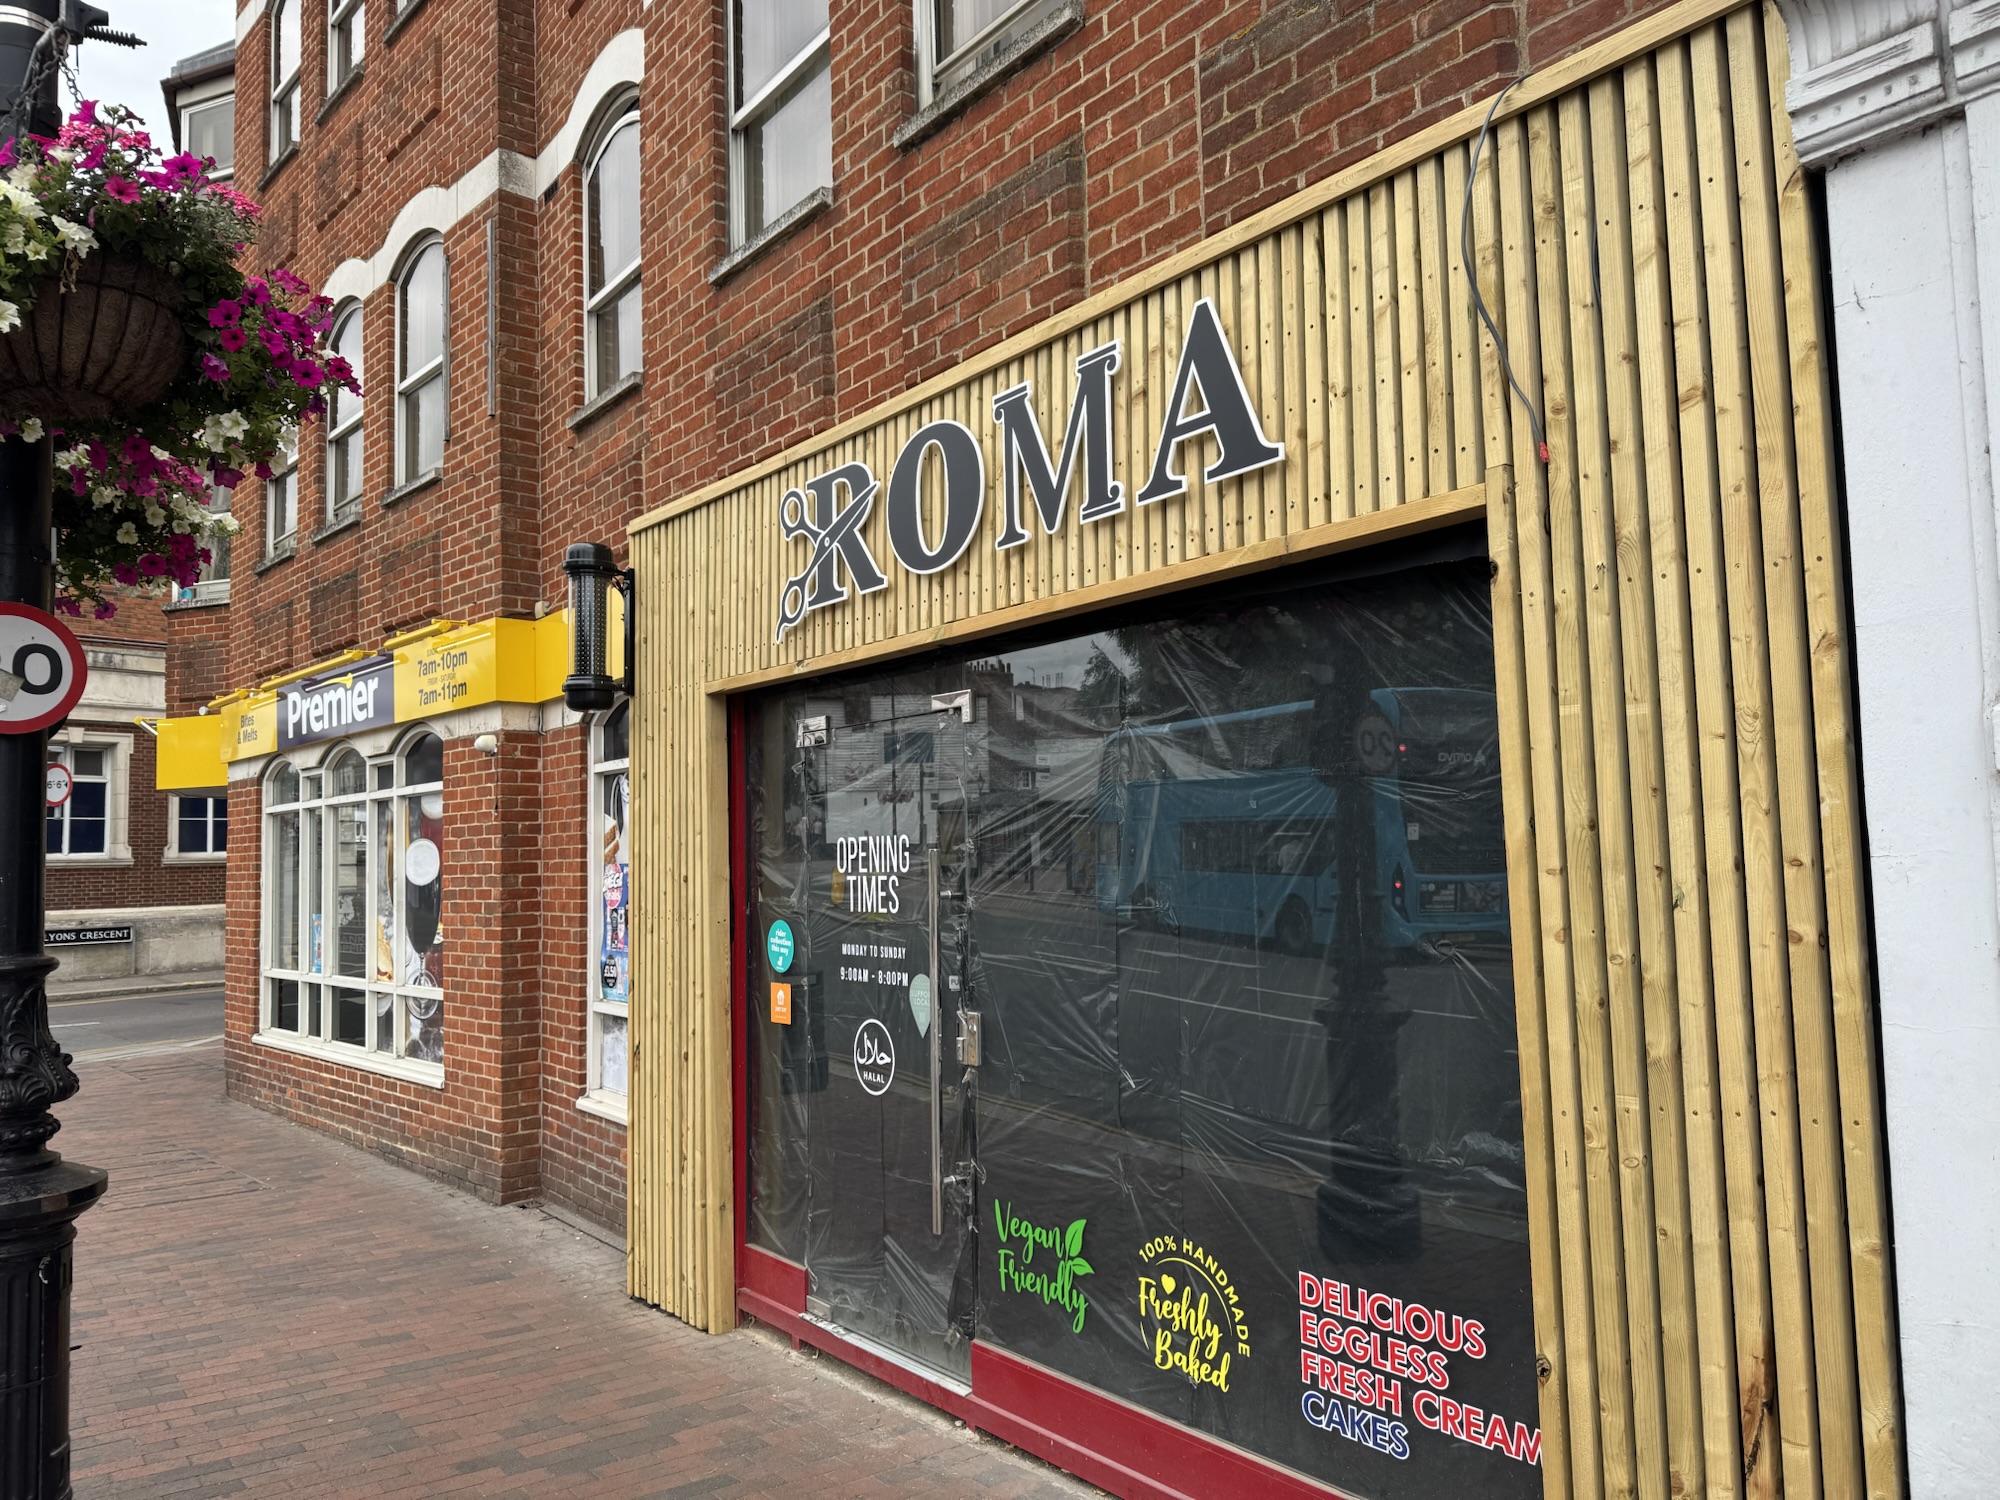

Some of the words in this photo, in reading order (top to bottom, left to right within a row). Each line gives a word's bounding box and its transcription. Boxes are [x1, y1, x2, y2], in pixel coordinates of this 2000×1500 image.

[779, 297, 1285, 640] ROMA
[0, 643, 63, 695] 0
[418, 650, 468, 677] 7am-10pm
[287, 674, 379, 740] Premier
[418, 681, 467, 707] 7am-11pm
[237, 732, 242, 745] &
[242, 729, 258, 744] Melts
[240, 714, 255, 727] Bites
[836, 835, 910, 873] OPENING
[846, 874, 899, 914] TIMES
[79, 930, 129, 940] CRESCENT
[770, 936, 792, 947] collection
[841, 943, 868, 957] MONDAY
[870, 945, 878, 958] TO
[880, 946, 906, 960] SUNDAY
[840, 966, 869, 982] 9:00AM
[878, 970, 909, 987] 8:00PM
[863, 1070, 885, 1084] HALAL
[994, 1199, 1064, 1264] Vegan
[998, 1249, 1090, 1334] Friendly
[1139, 1235, 1177, 1263] 100%
[1182, 1238, 1250, 1358] HANDMADE
[1298, 1271, 1486, 1359] DELICIOUS
[1138, 1276, 1222, 1360] Freshly
[1154, 1328, 1230, 1393] Baked
[1299, 1310, 1449, 1390] EGGLESS
[1301, 1349, 1402, 1417] FRESH
[1413, 1390, 1543, 1466] CREAM
[1301, 1390, 1410, 1461] CAKES
